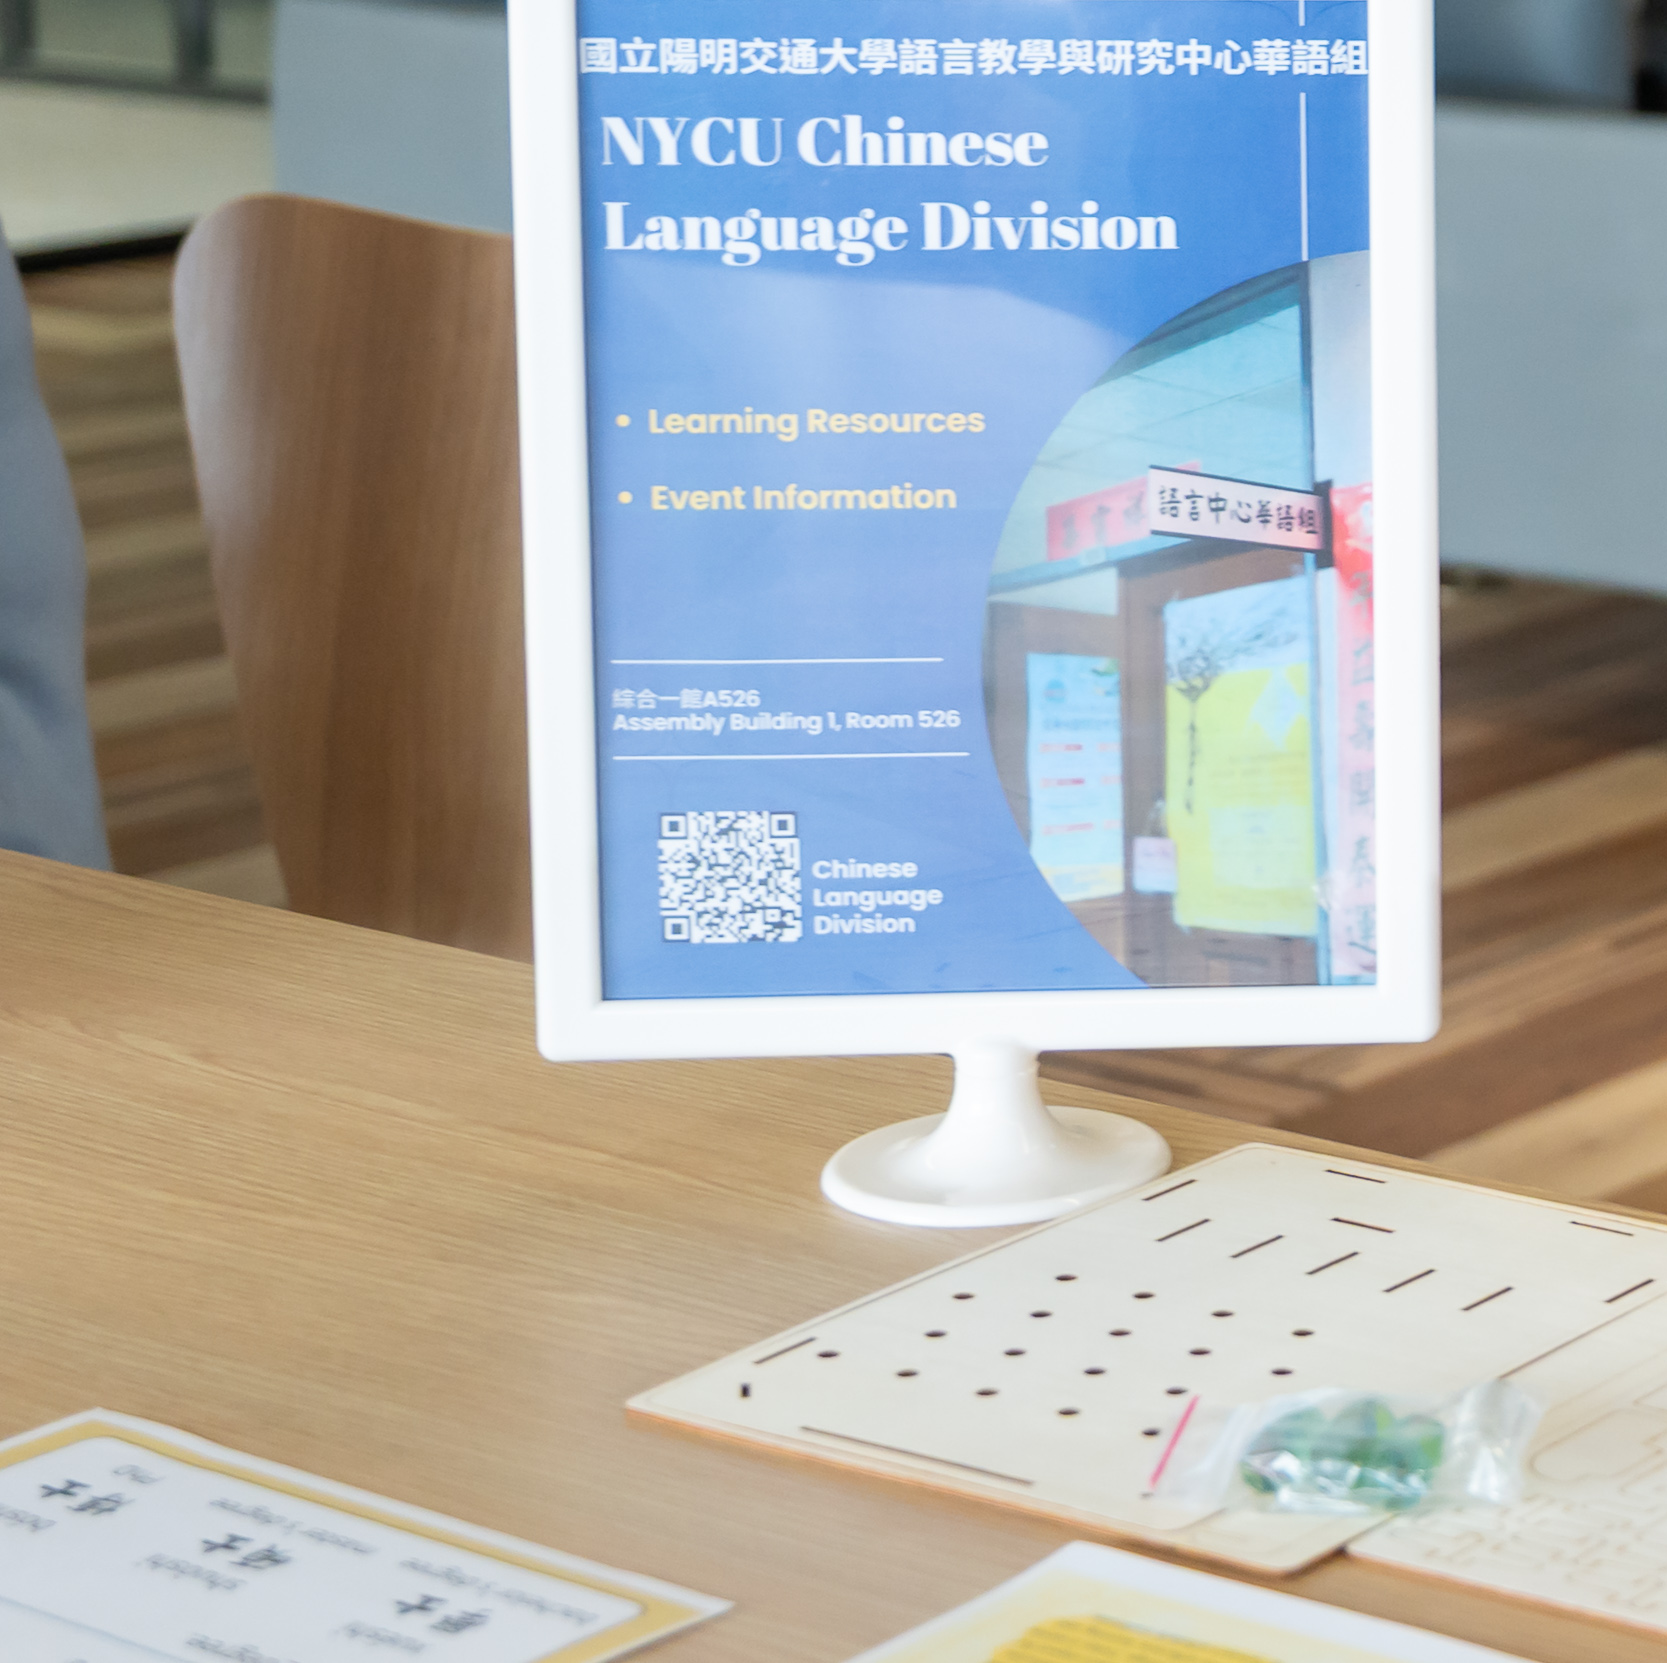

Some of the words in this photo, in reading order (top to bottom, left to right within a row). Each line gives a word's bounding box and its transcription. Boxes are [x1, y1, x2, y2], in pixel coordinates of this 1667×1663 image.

[579, 36, 1369, 77] 國立陽明交通大學語言教學與研究中心華語組
[600, 115, 785, 167] NYCU
[797, 114, 1049, 167] Chinese
[602, 201, 909, 267] Language
[920, 199, 1181, 251] Division
[648, 406, 799, 442] Learning
[806, 408, 986, 434] Resources
[650, 485, 747, 511] Event
[753, 482, 958, 510] Information
[1157, 486, 1319, 535] 語言中心華語組
[612, 712, 725, 736] Assembly
[729, 711, 824, 736] Building
[826, 712, 843, 732] 1,
[846, 712, 914, 729] Room
[918, 709, 962, 729] 526
[811, 858, 919, 879] Chinese
[812, 888, 944, 912] Language
[813, 912, 917, 935] Division
